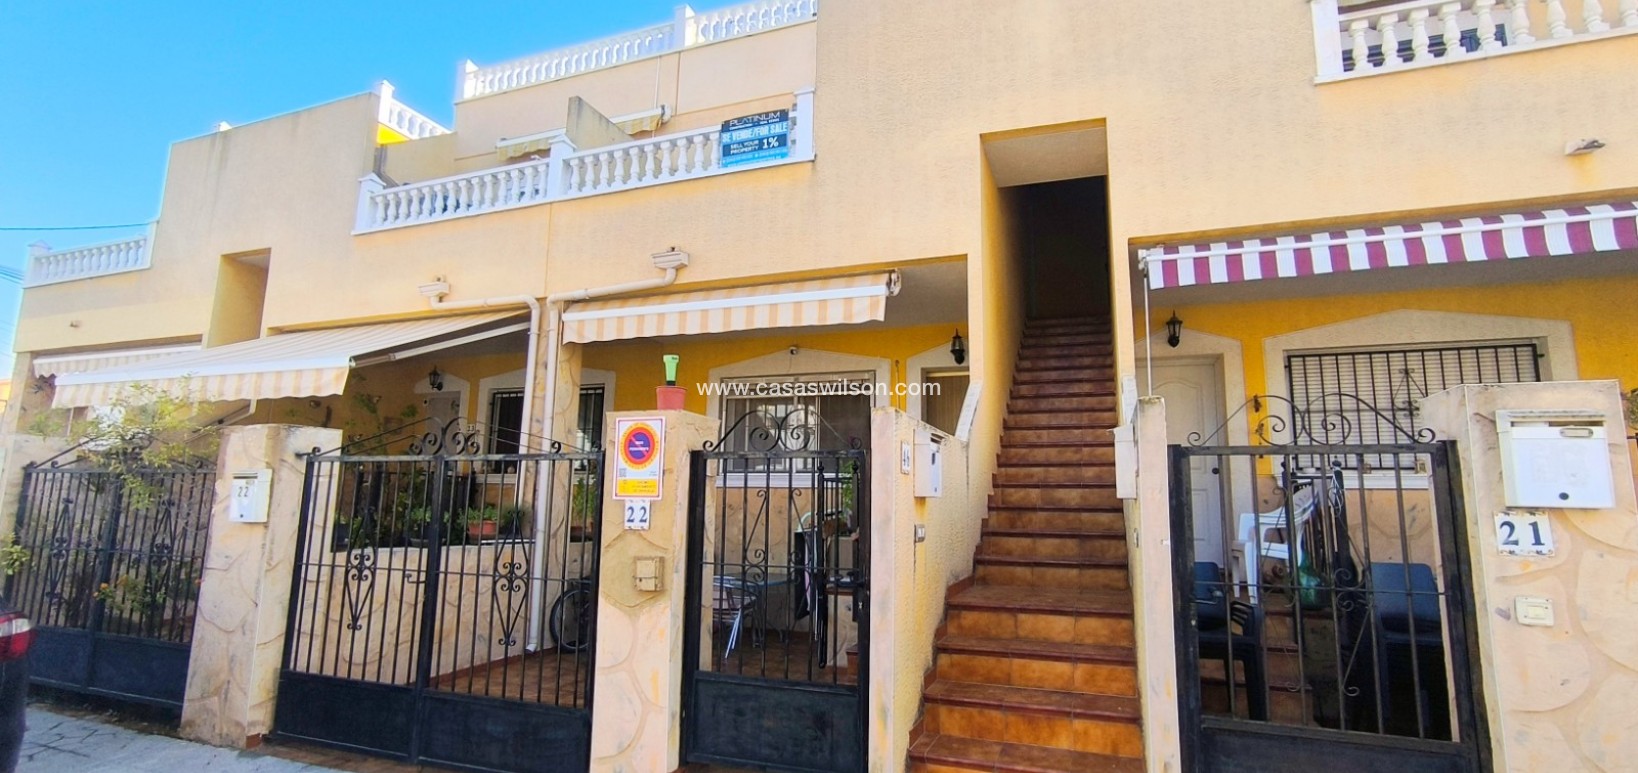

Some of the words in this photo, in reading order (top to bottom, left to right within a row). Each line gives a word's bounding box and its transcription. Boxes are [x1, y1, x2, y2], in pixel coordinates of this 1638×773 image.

[729, 112, 781, 127] PLATINUM
[722, 132, 731, 142] SE
[770, 122, 788, 133] SALE
[730, 145, 760, 155] PROPERTY
[762, 136, 779, 149] 1%
[237, 486, 249, 498] 22
[626, 506, 648, 523] 22
[1499, 520, 1546, 546] 21
